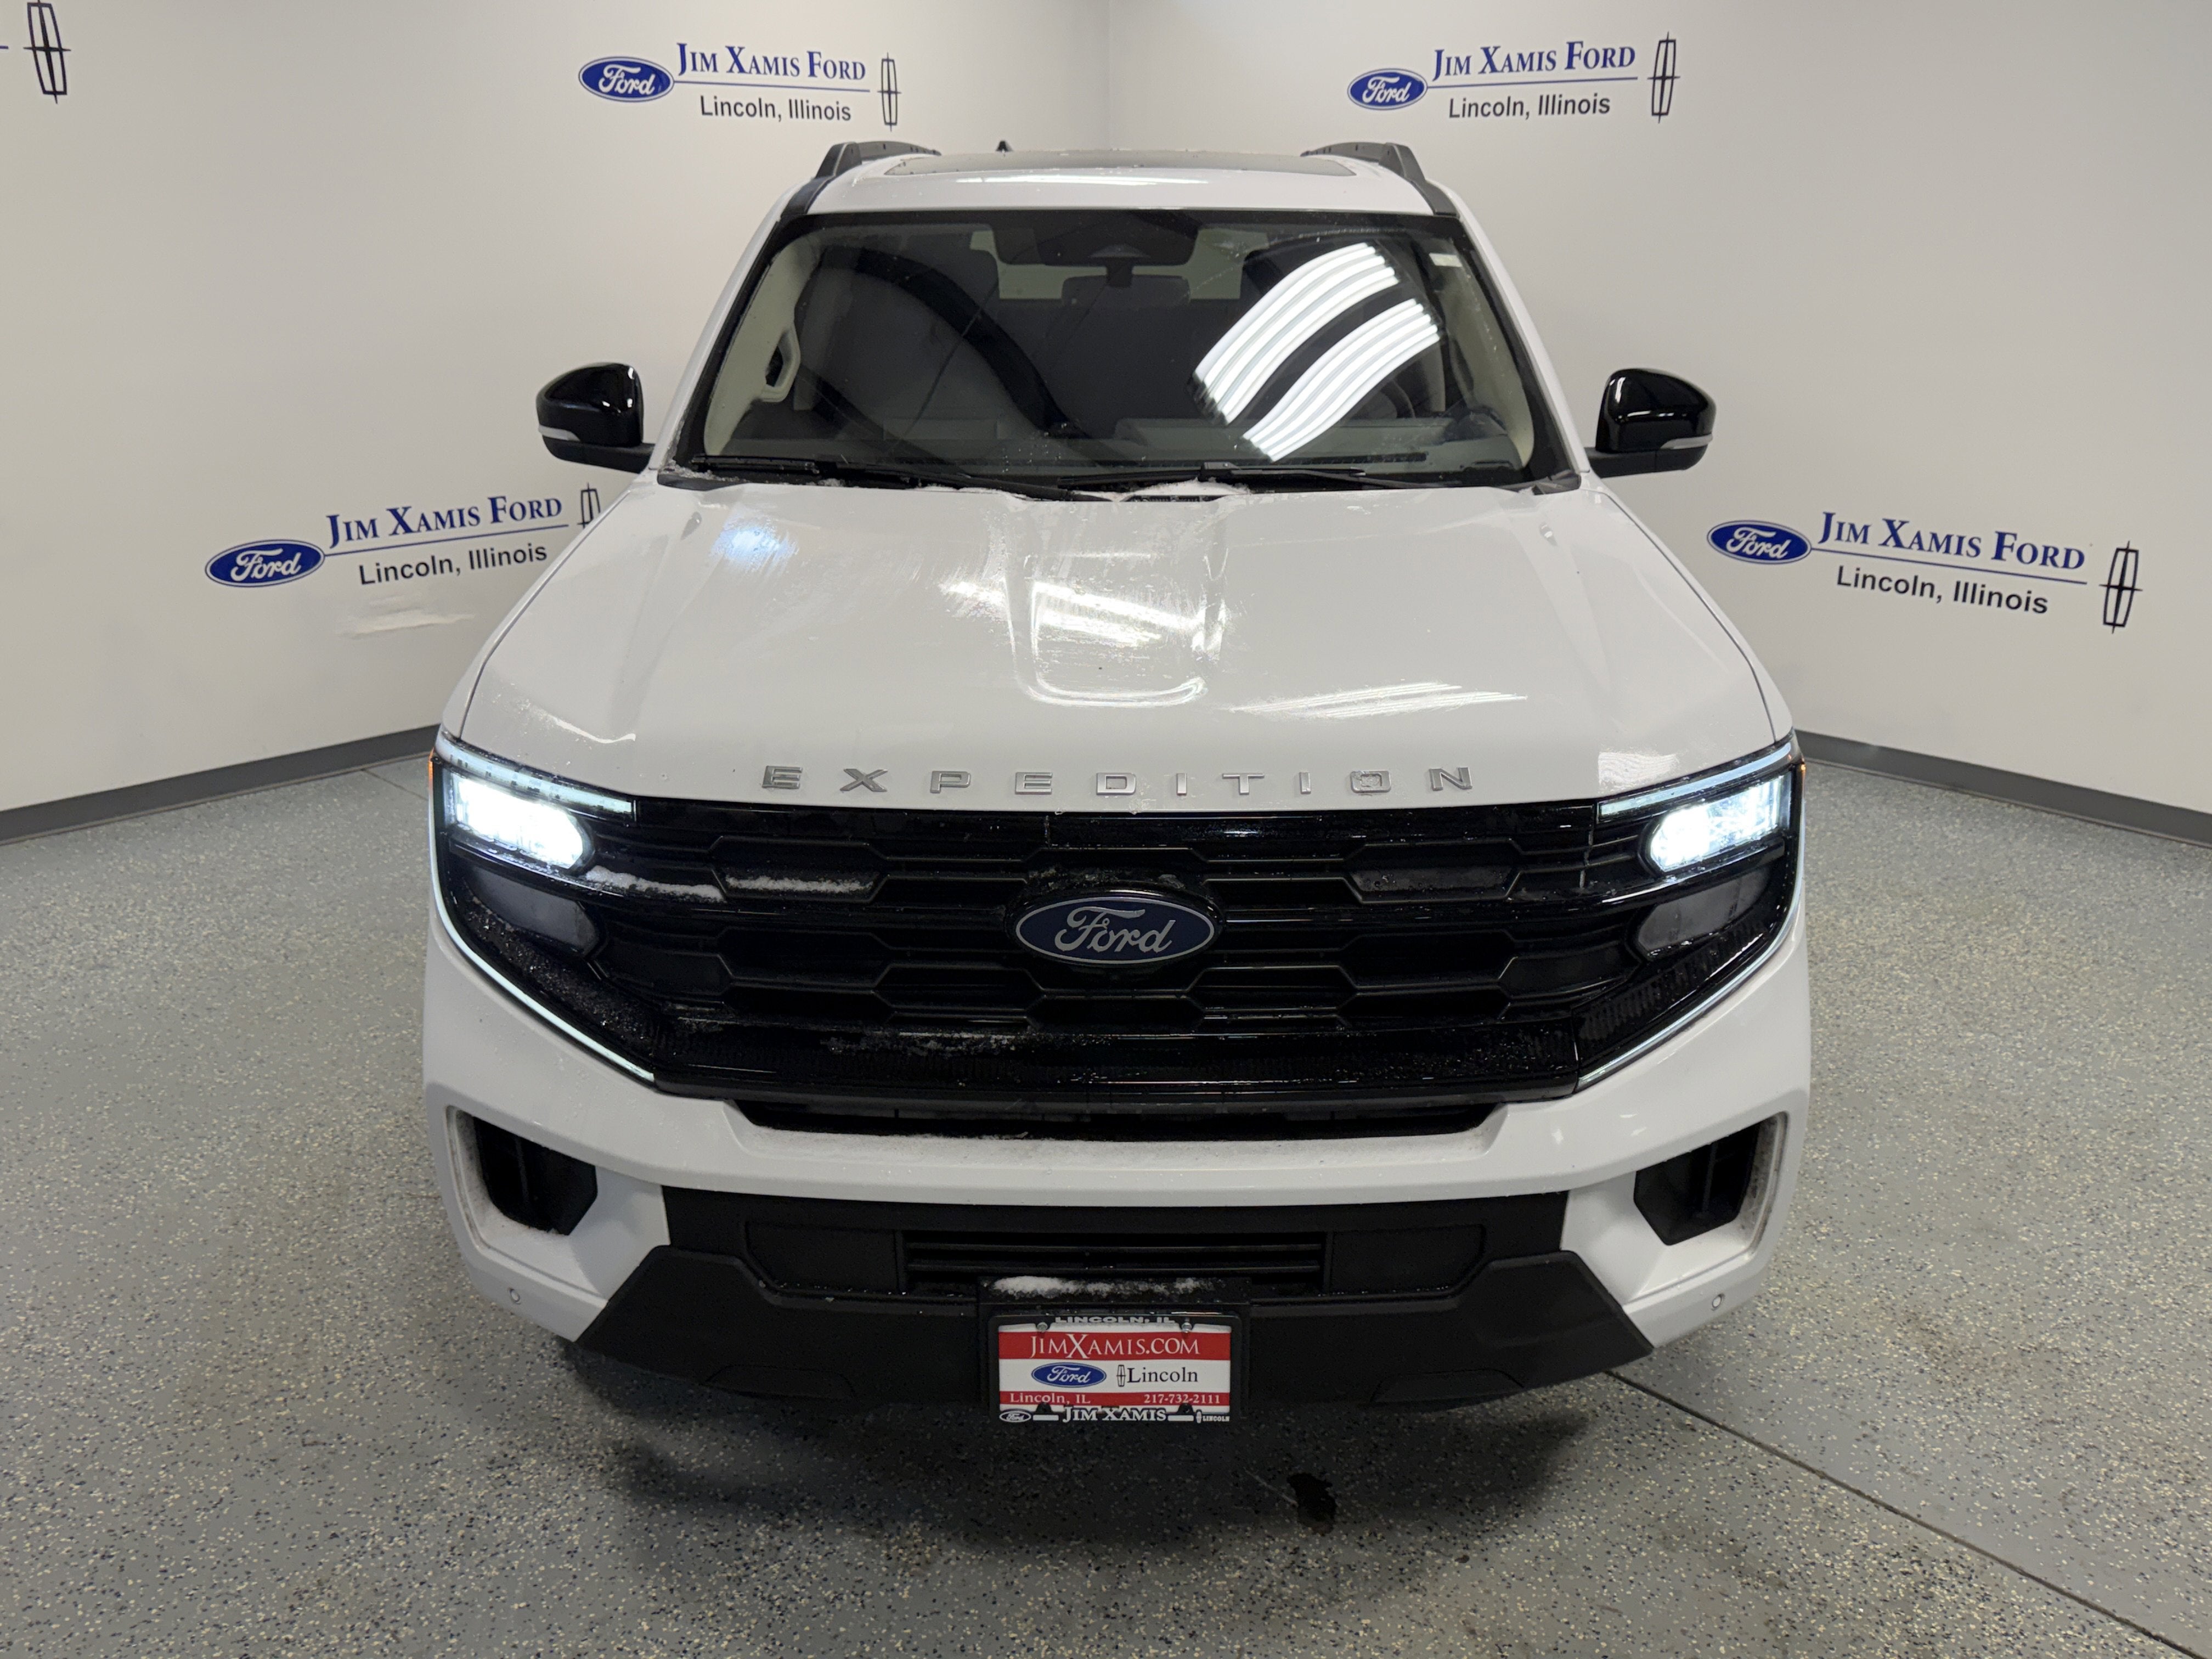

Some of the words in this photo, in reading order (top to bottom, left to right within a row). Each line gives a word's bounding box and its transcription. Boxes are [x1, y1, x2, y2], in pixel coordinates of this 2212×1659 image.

[598, 61, 656, 97] Ford
[1362, 76, 1410, 104] Ford
[700, 96, 782, 122] Lincoln,
[788, 99, 851, 121] Illinois
[1449, 97, 1531, 120] Lincoln,
[1538, 93, 1611, 116] Illinois
[1725, 526, 1790, 559] Ford
[229, 548, 302, 582] Ford
[358, 555, 462, 585] Lincoln,
[468, 543, 548, 571] Illinois
[1836, 565, 1943, 605] Lincoln,
[1953, 580, 2049, 614] Illinois
[762, 765, 1474, 793] EXPEDITION
[1054, 905, 1173, 955] Ford
[1047, 1365, 1091, 1383] Ford
[1127, 1367, 1198, 1383] Lincoln
[1009, 1392, 1070, 1404] Lincoln,
[1076, 1394, 1091, 1403] IL
[1144, 1394, 1221, 1404] 217-732-2111
